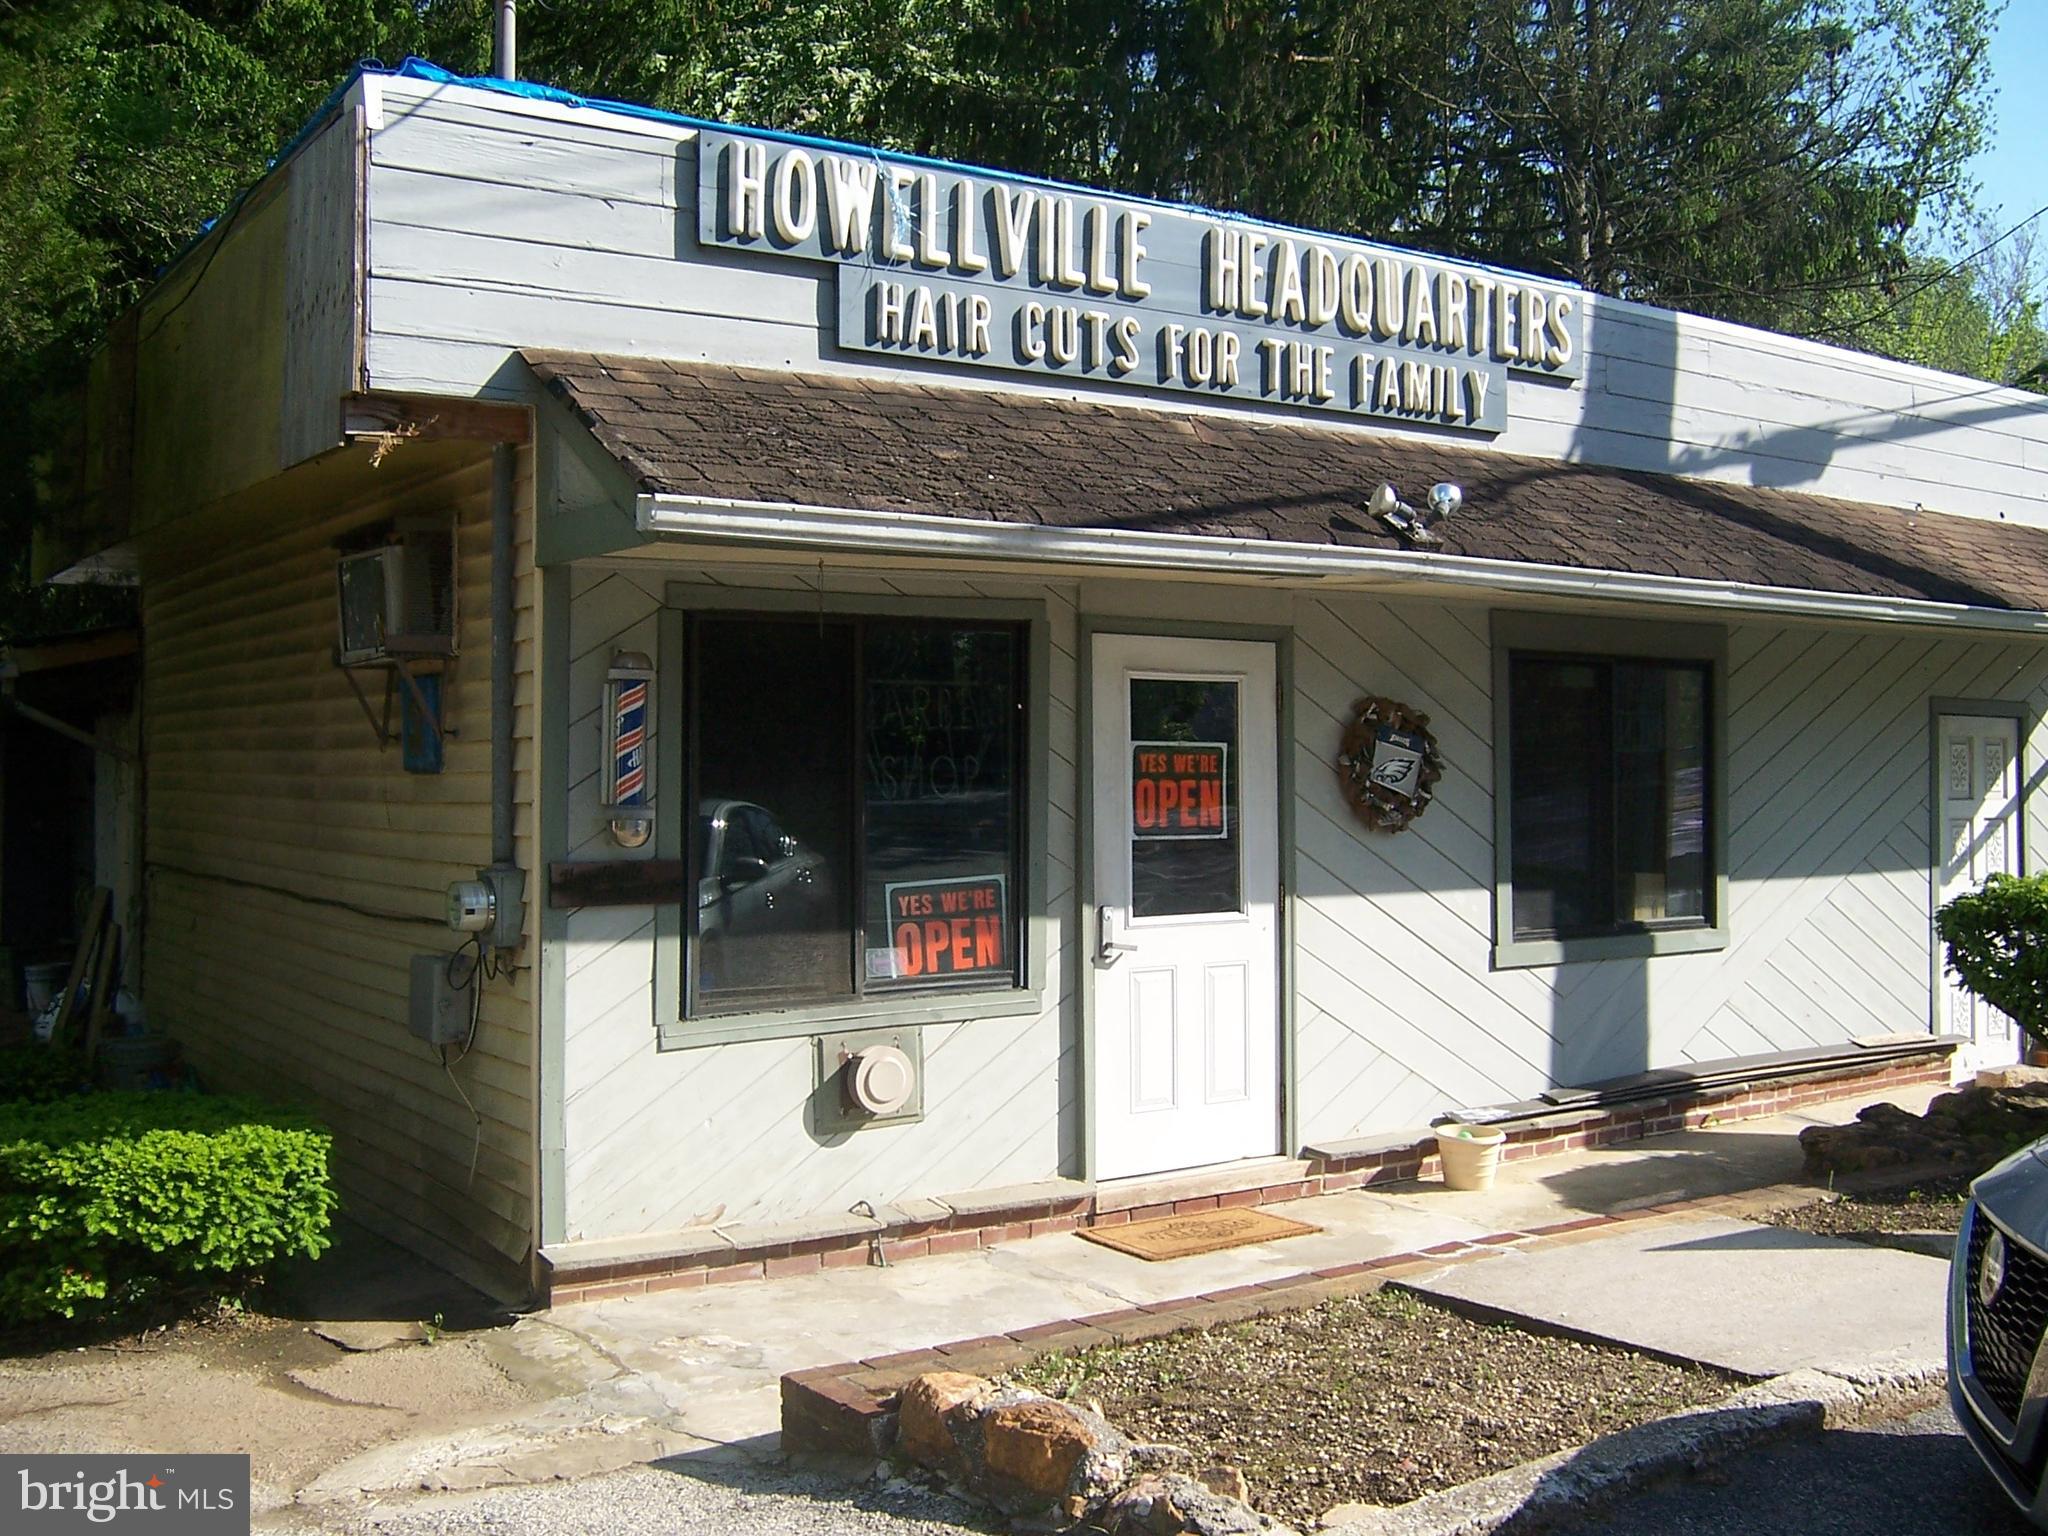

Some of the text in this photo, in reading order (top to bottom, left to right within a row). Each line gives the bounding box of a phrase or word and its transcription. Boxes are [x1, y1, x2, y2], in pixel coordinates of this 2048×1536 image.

[728, 140, 1573, 366] HOWELLVILLE HEADQUARTERS
[877, 280, 1489, 420] HAIR CUTS FOR THE FAMILY
[1139, 753, 1218, 774] YES WE'RE
[1135, 778, 1222, 829] OPEN
[898, 888, 996, 916] YES WE'RE
[896, 915, 1001, 976] OPEN
